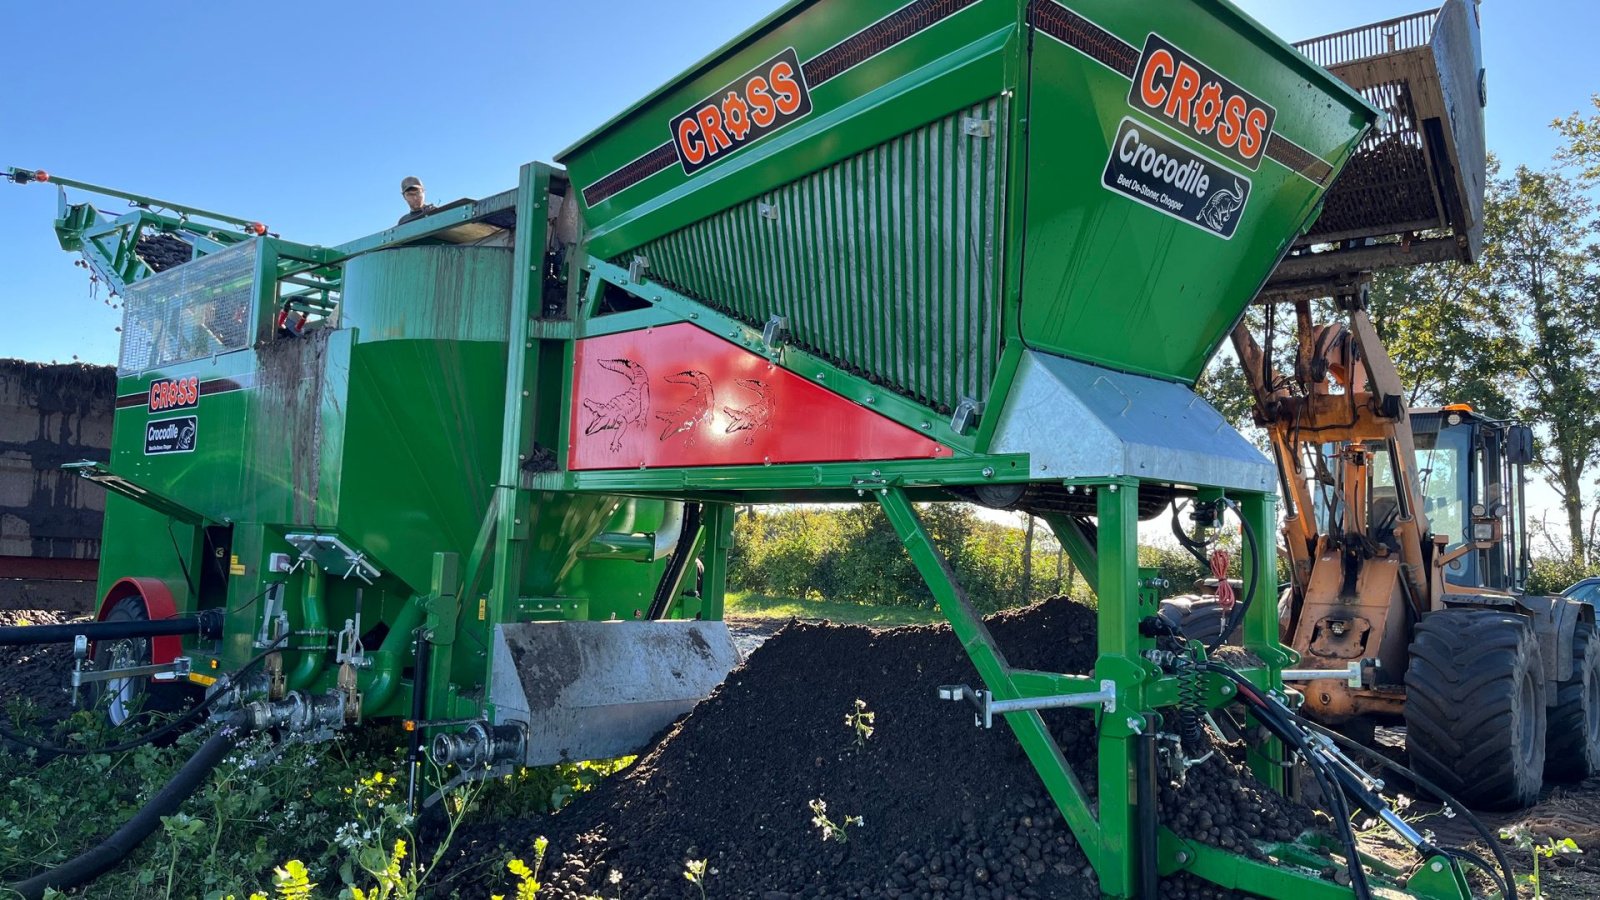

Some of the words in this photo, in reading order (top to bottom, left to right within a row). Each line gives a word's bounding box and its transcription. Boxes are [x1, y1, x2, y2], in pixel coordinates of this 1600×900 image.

[678, 61, 801, 164] CROSS
[1141, 49, 1267, 159] CROSS
[1119, 128, 1210, 198] Crocodile
[1116, 173, 1132, 189] Beet
[1131, 180, 1160, 202] De-Stoner,
[1159, 193, 1184, 211] Chopper
[150, 376, 198, 410] CROSS
[148, 423, 179, 441] Crocodile
